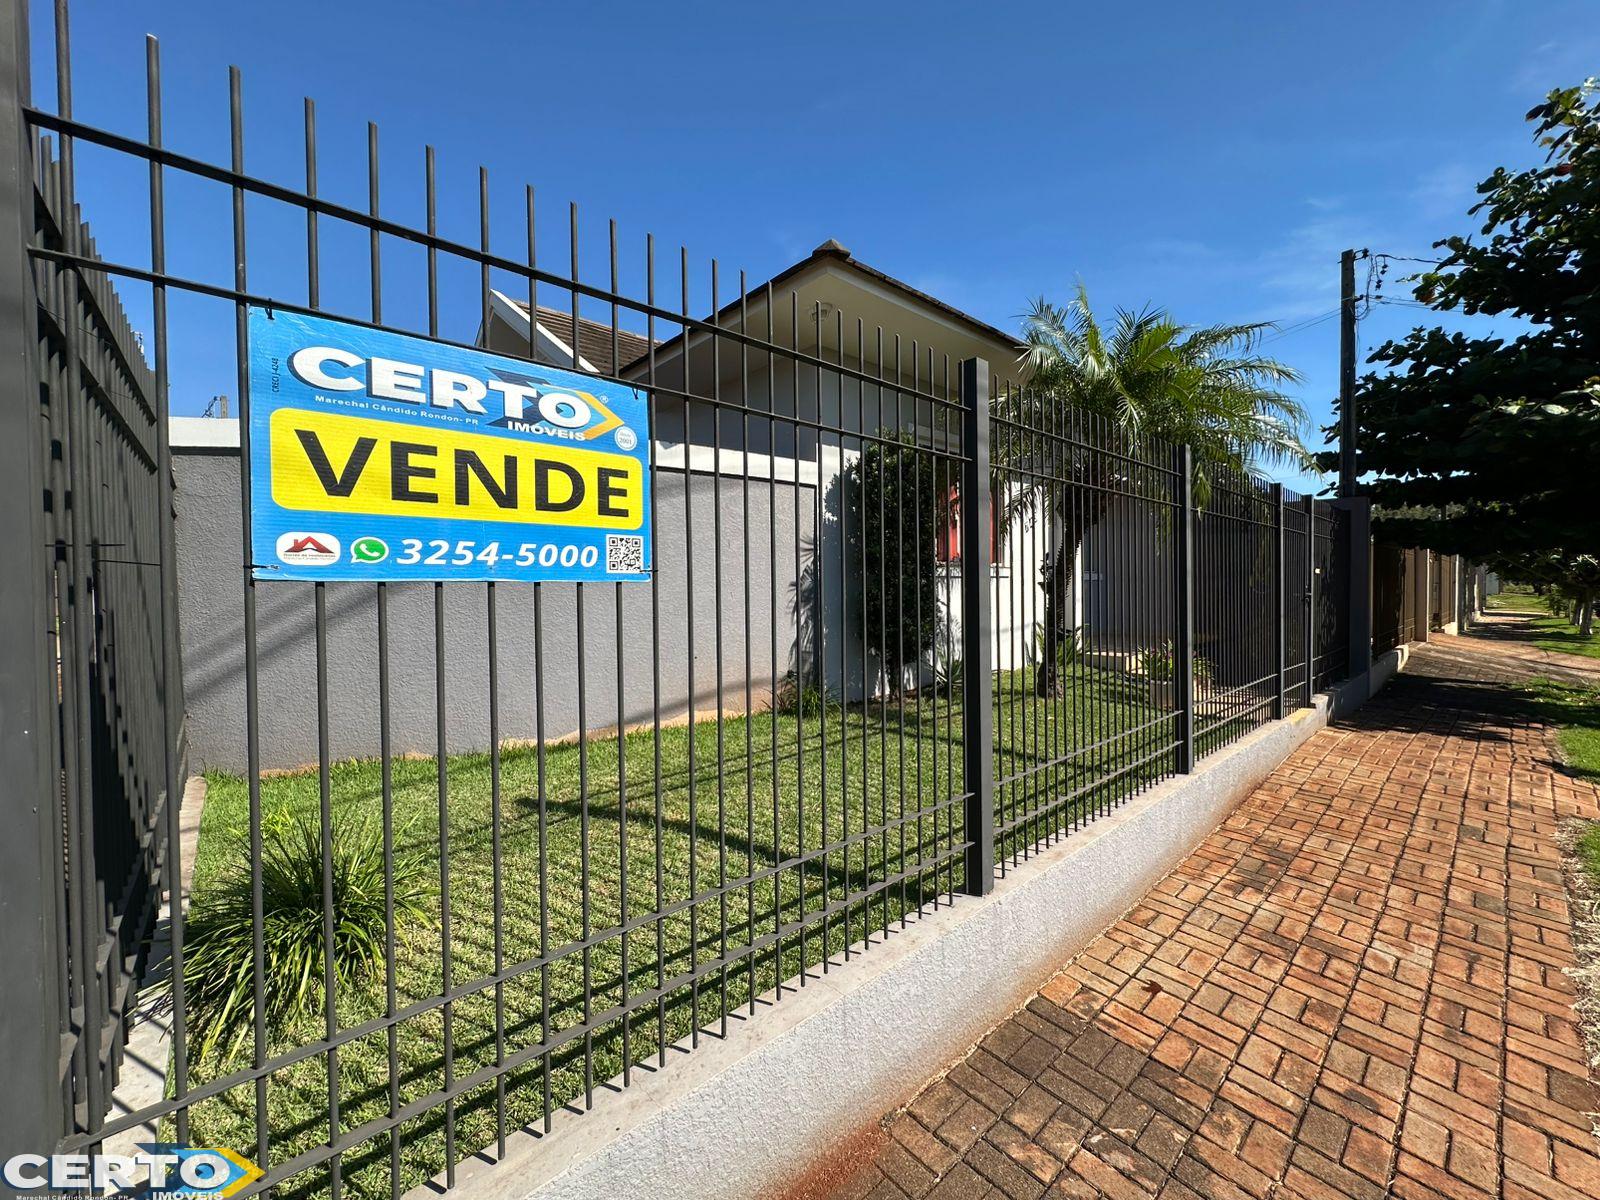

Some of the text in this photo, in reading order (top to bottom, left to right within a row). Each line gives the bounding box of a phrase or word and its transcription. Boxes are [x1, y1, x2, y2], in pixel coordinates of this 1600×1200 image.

[287, 346, 593, 430] CERTO
[314, 394, 369, 410] Marechal
[372, 403, 418, 417] Cândido
[465, 417, 479, 425] PR
[294, 429, 630, 519] VENDE
[396, 538, 600, 569] 3254-5000
